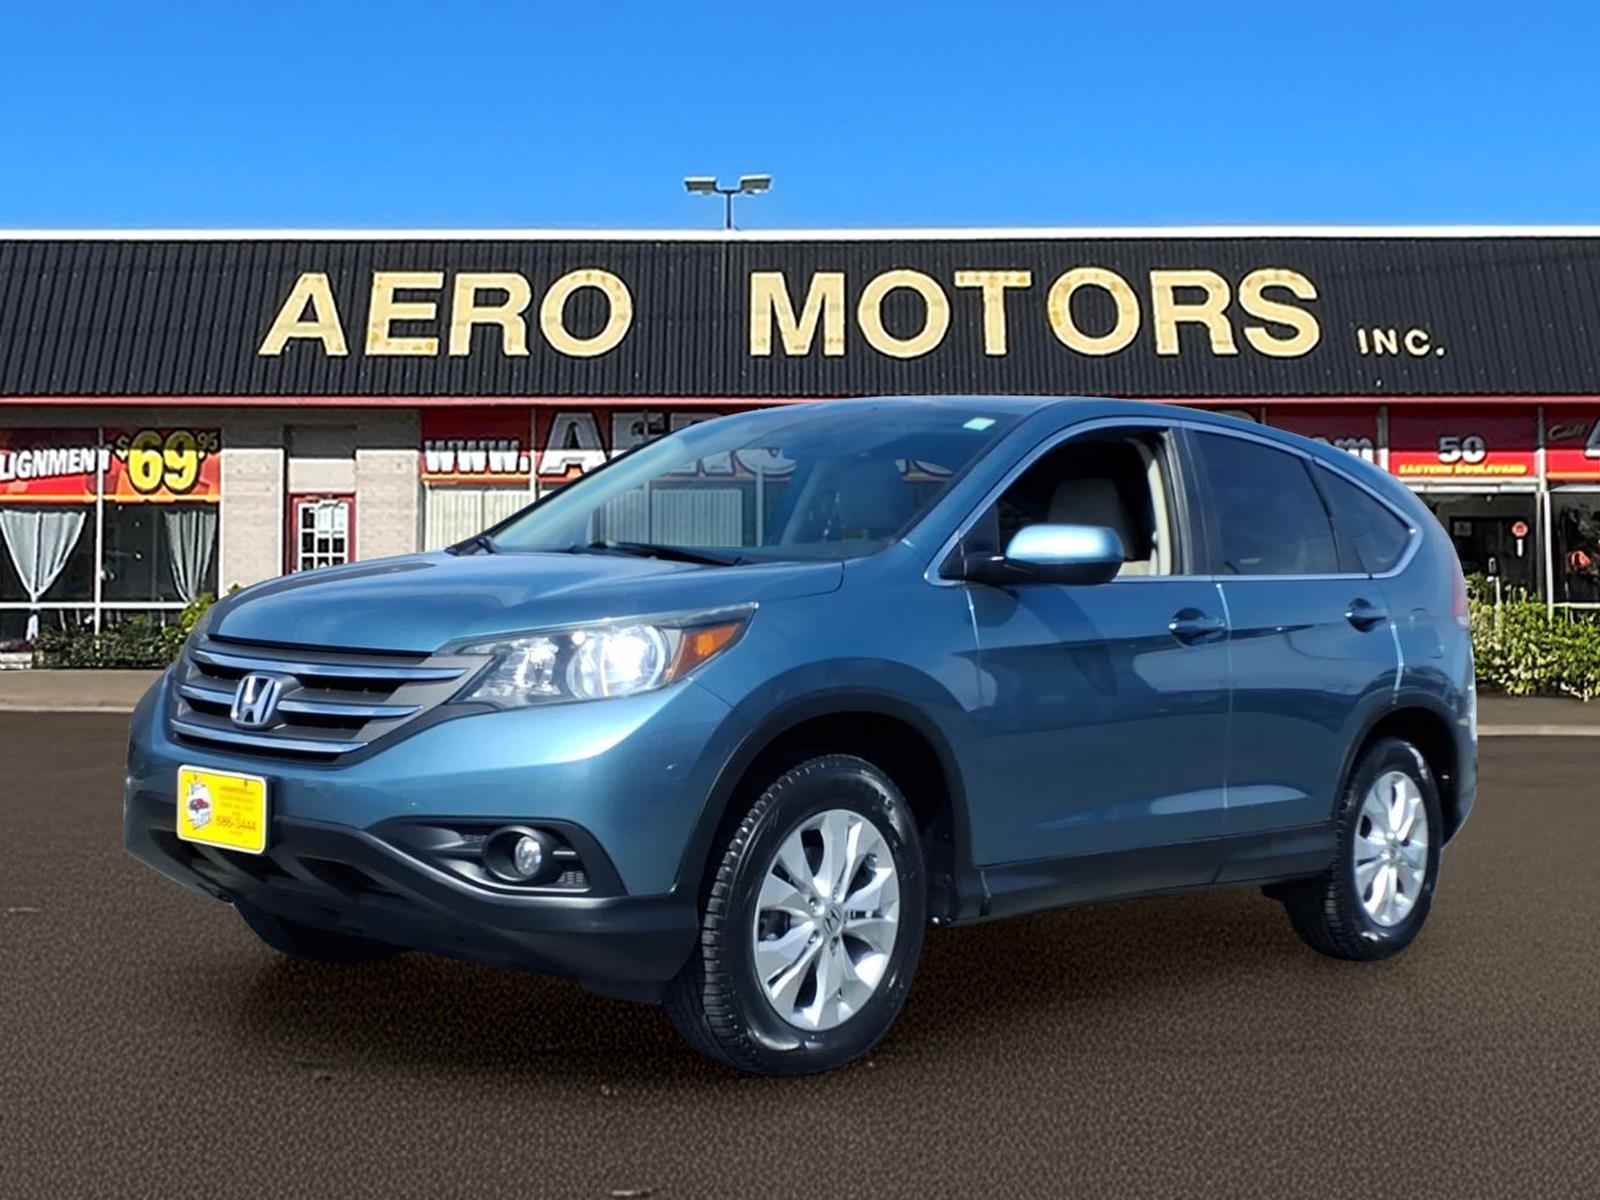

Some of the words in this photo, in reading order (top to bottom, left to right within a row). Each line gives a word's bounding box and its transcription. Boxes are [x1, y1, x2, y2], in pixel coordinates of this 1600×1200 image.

[258, 268, 633, 357] AERO
[750, 267, 1320, 357] MOTORS
[1357, 328, 1447, 357] INC.
[1437, 436, 1485, 463] 50
[1398, 464, 1452, 474] EASTERN
[1455, 464, 1527, 474] BOULEVARD
